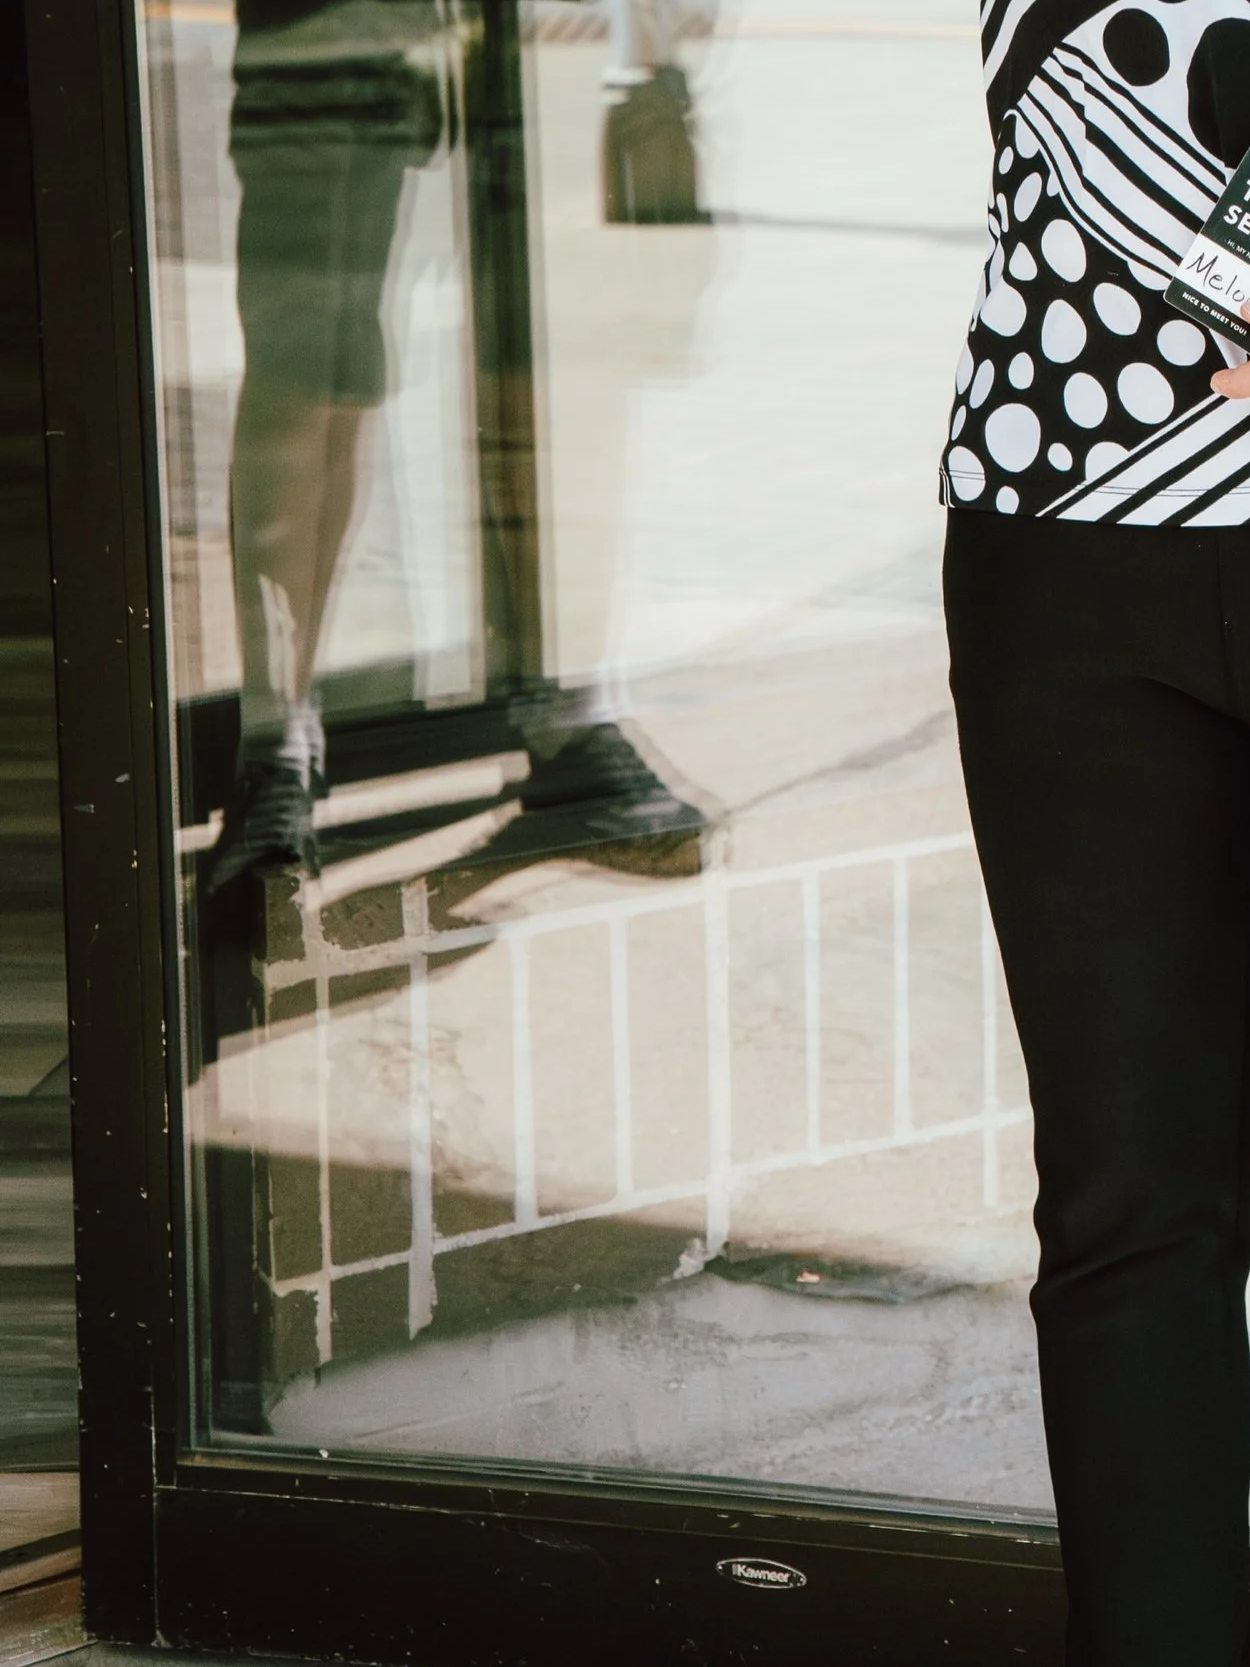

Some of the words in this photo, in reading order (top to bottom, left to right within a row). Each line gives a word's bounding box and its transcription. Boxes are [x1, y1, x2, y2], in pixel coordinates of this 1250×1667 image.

[1236, 245, 1247, 254] MY
[1182, 291, 1200, 307] NICE
[1200, 302, 1210, 313] TO
[1210, 309, 1229, 325] MEET
[1229, 320, 1248, 336] YOU!
[737, 1564, 791, 1583] Kawneer
